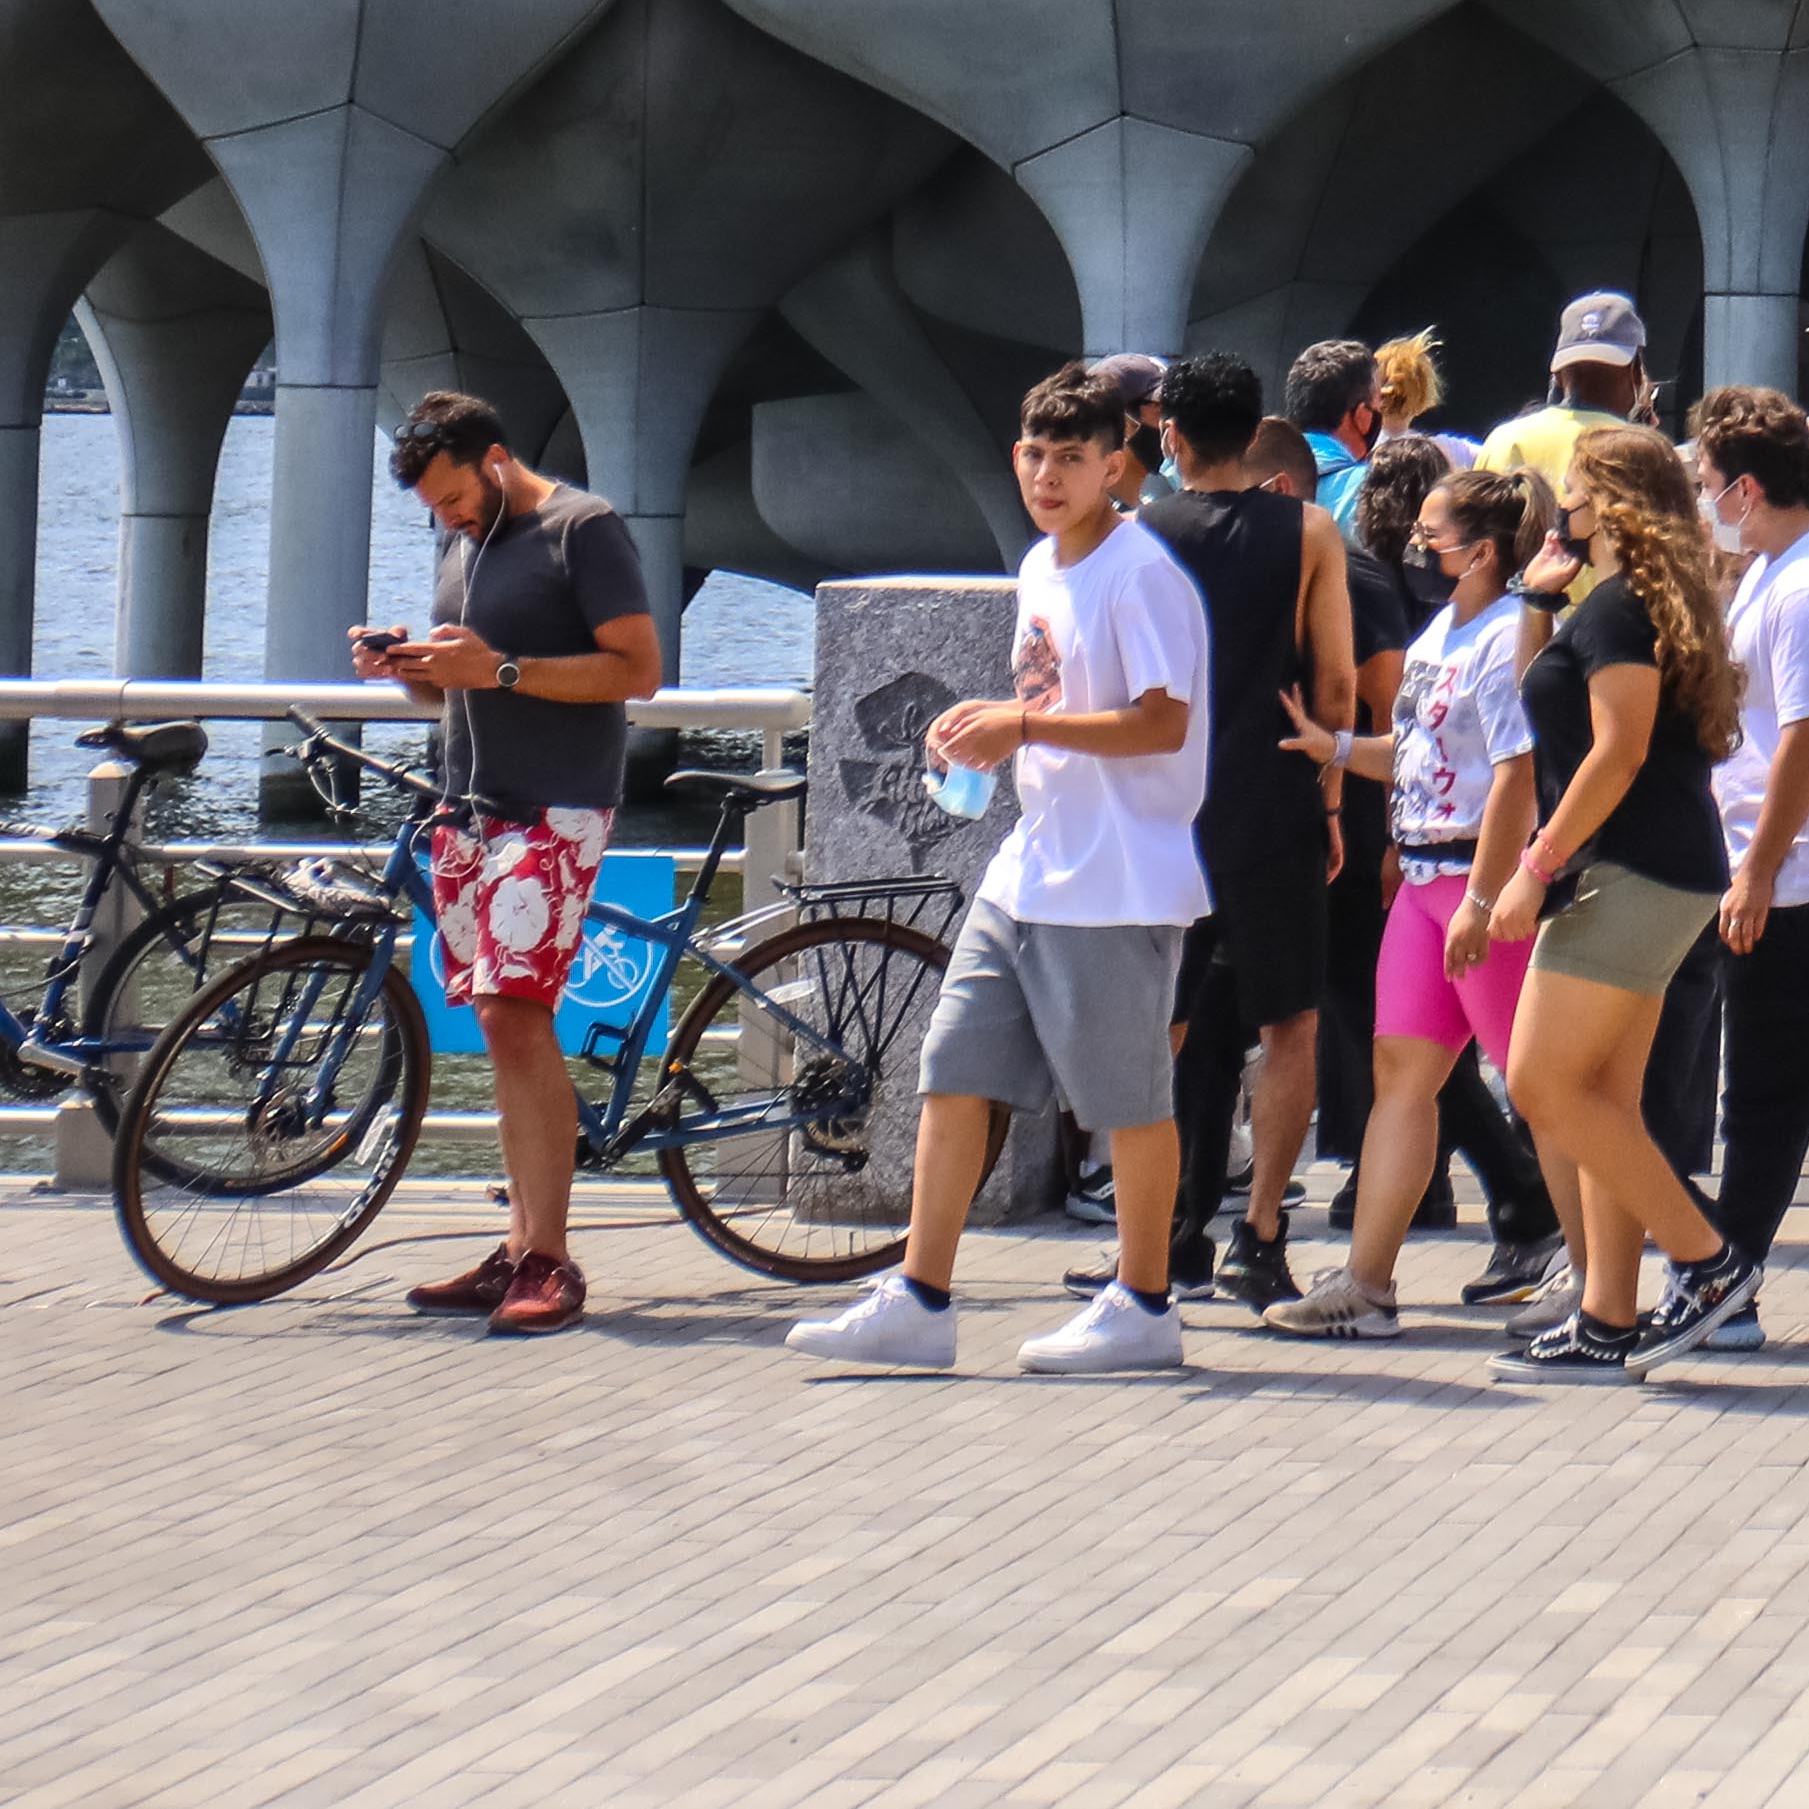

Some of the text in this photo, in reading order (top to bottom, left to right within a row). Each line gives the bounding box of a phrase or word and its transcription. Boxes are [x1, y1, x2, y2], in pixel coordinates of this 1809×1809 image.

[1428, 666, 1457, 822] スターウォ
